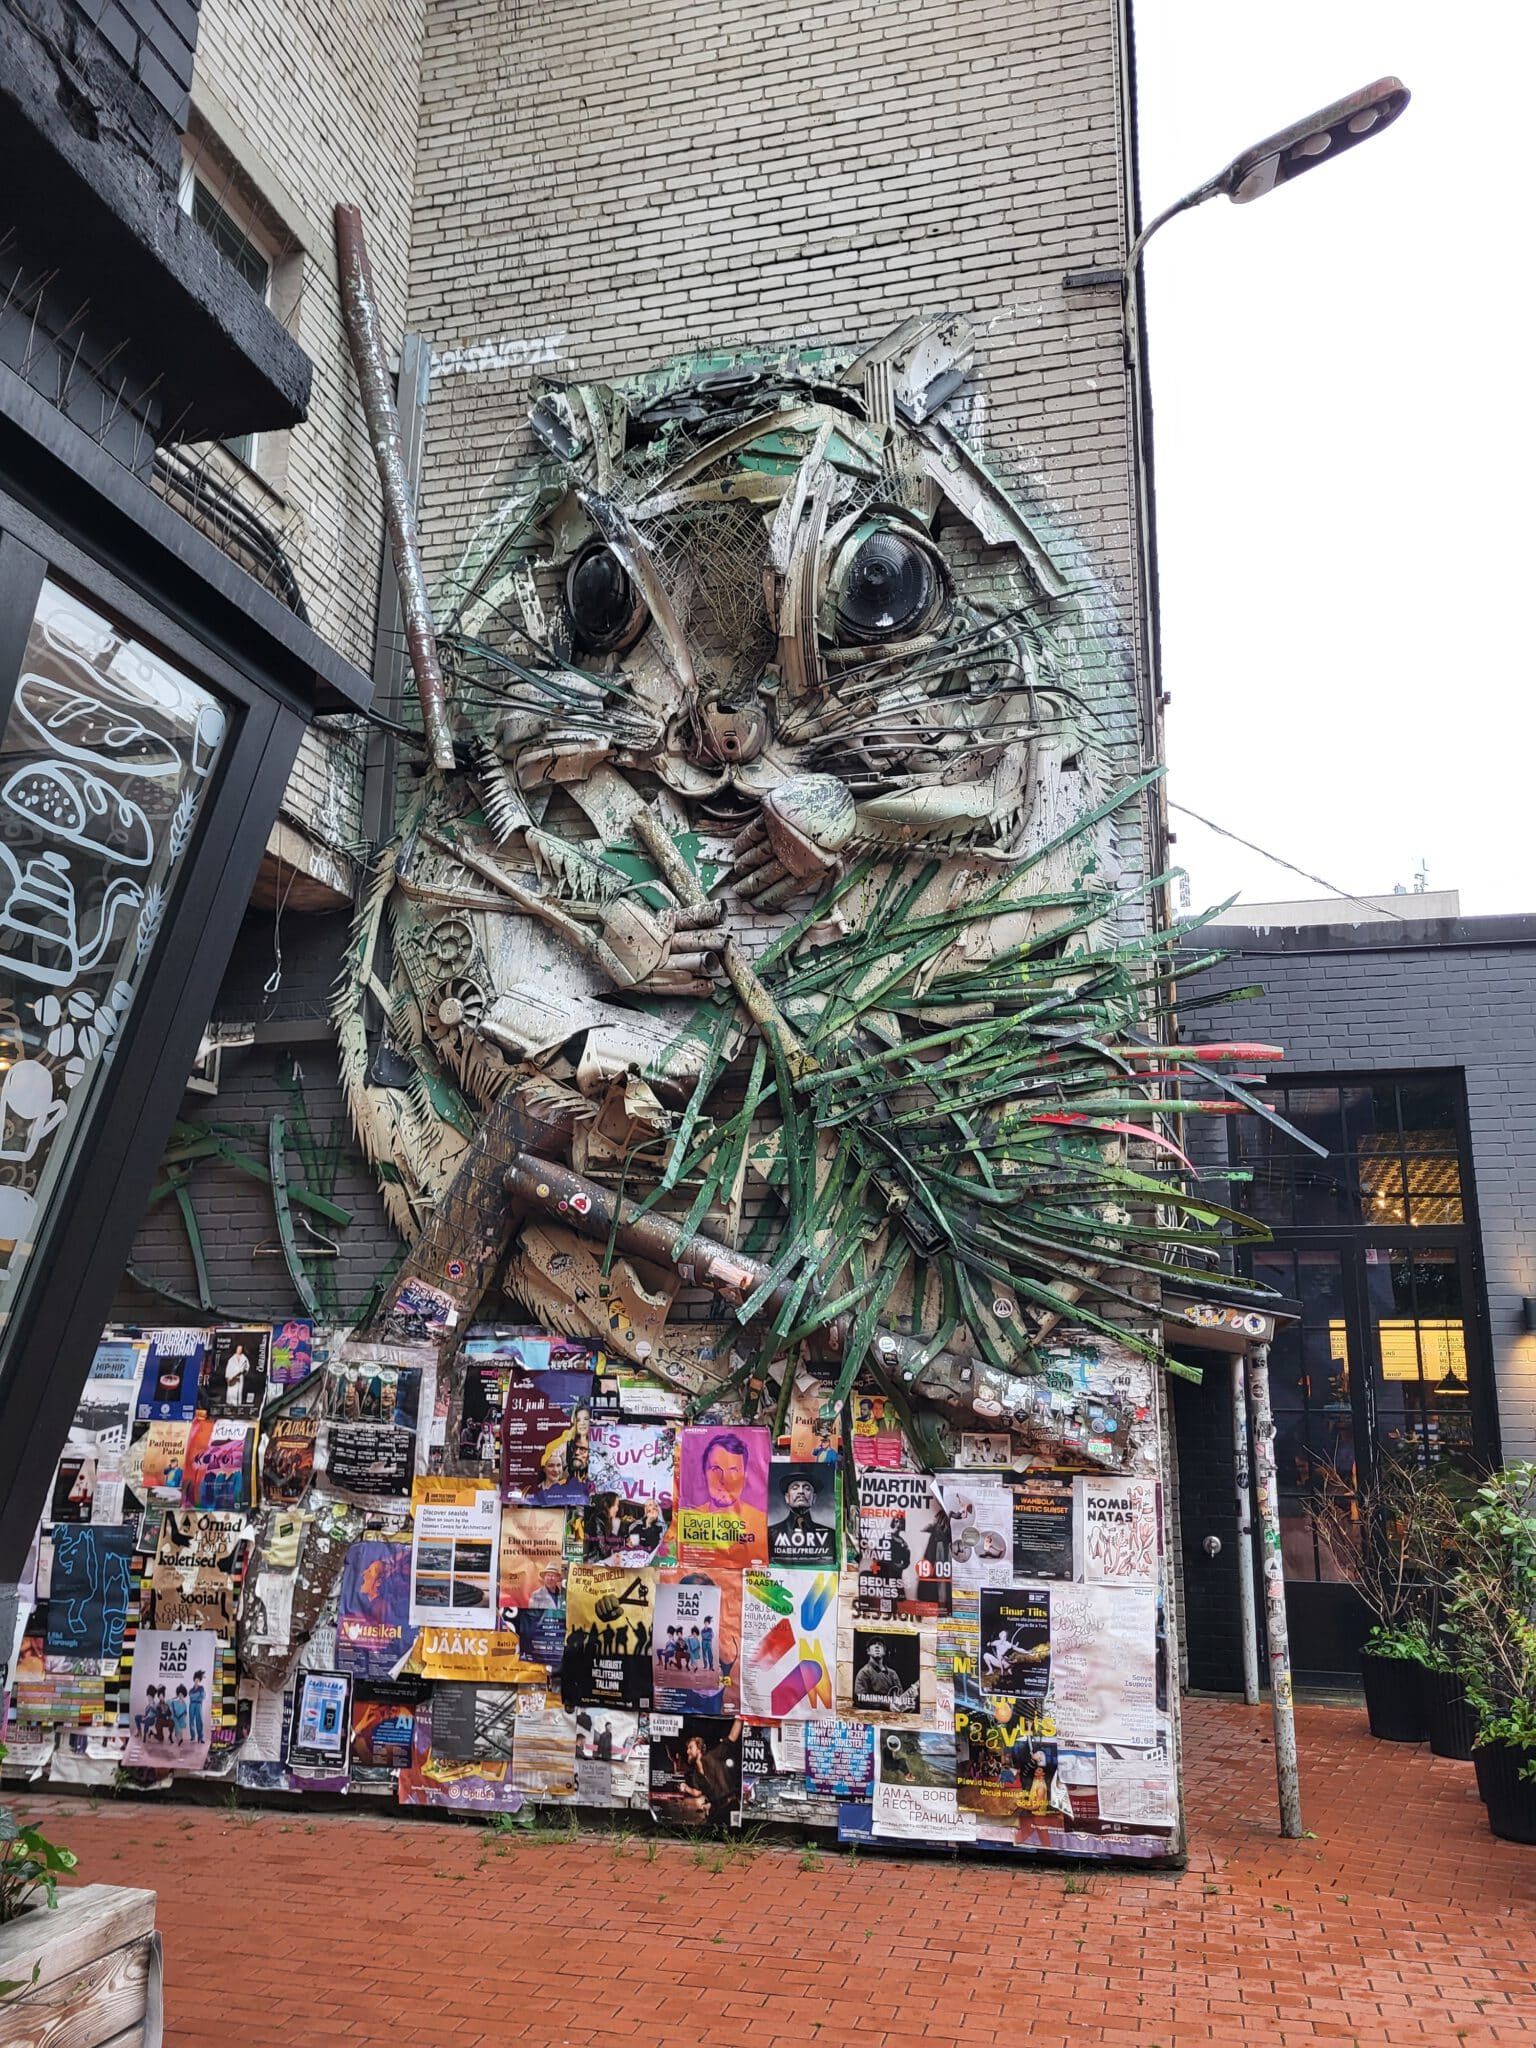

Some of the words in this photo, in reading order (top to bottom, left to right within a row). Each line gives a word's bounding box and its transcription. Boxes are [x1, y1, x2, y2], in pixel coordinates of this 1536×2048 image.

[155, 1343, 197, 1356] RESTORAN
[862, 1478, 927, 1493] MARTIN
[861, 1493, 934, 1509] DUPONT
[1087, 1497, 1133, 1509] KOMBI
[860, 1508, 907, 1518] FRENCH
[1087, 1510, 1134, 1523] NATAS
[683, 1516, 714, 1529] Laval
[717, 1518, 746, 1529] koos
[860, 1518, 887, 1528] NEW
[683, 1528, 710, 1541] Kait
[711, 1529, 755, 1545] Kalliga
[774, 1528, 829, 1547] MÕRV
[860, 1528, 892, 1539] WAVE
[860, 1539, 891, 1549] COLD
[158, 1551, 217, 1568] koletised
[860, 1549, 892, 1561] WAVE
[745, 1570, 772, 1578] SAUND
[917, 1560, 930, 1577] 19
[935, 1561, 951, 1577] 09
[754, 1579, 784, 1587] AASTAT
[859, 1586, 899, 1598] BONES
[180, 1591, 219, 1605] soojal
[676, 1608, 700, 1616] NAD
[426, 1632, 489, 1656] JÄÄKS
[160, 1651, 188, 1661] JAN
[159, 1662, 187, 1672] NAD
[599, 1660, 623, 1670] AUGUST
[1131, 1674, 1153, 1682] Sonya
[596, 1680, 619, 1690] TALLINN
[1124, 1680, 1153, 1688] Isupova
[857, 1694, 893, 1704] TRAINMAN
[743, 1761, 769, 1774] 2025
[883, 1788, 901, 1798] AM
[892, 1800, 922, 1810] ЕСТЬ
[909, 1811, 965, 1825] ГРАНИЦА
